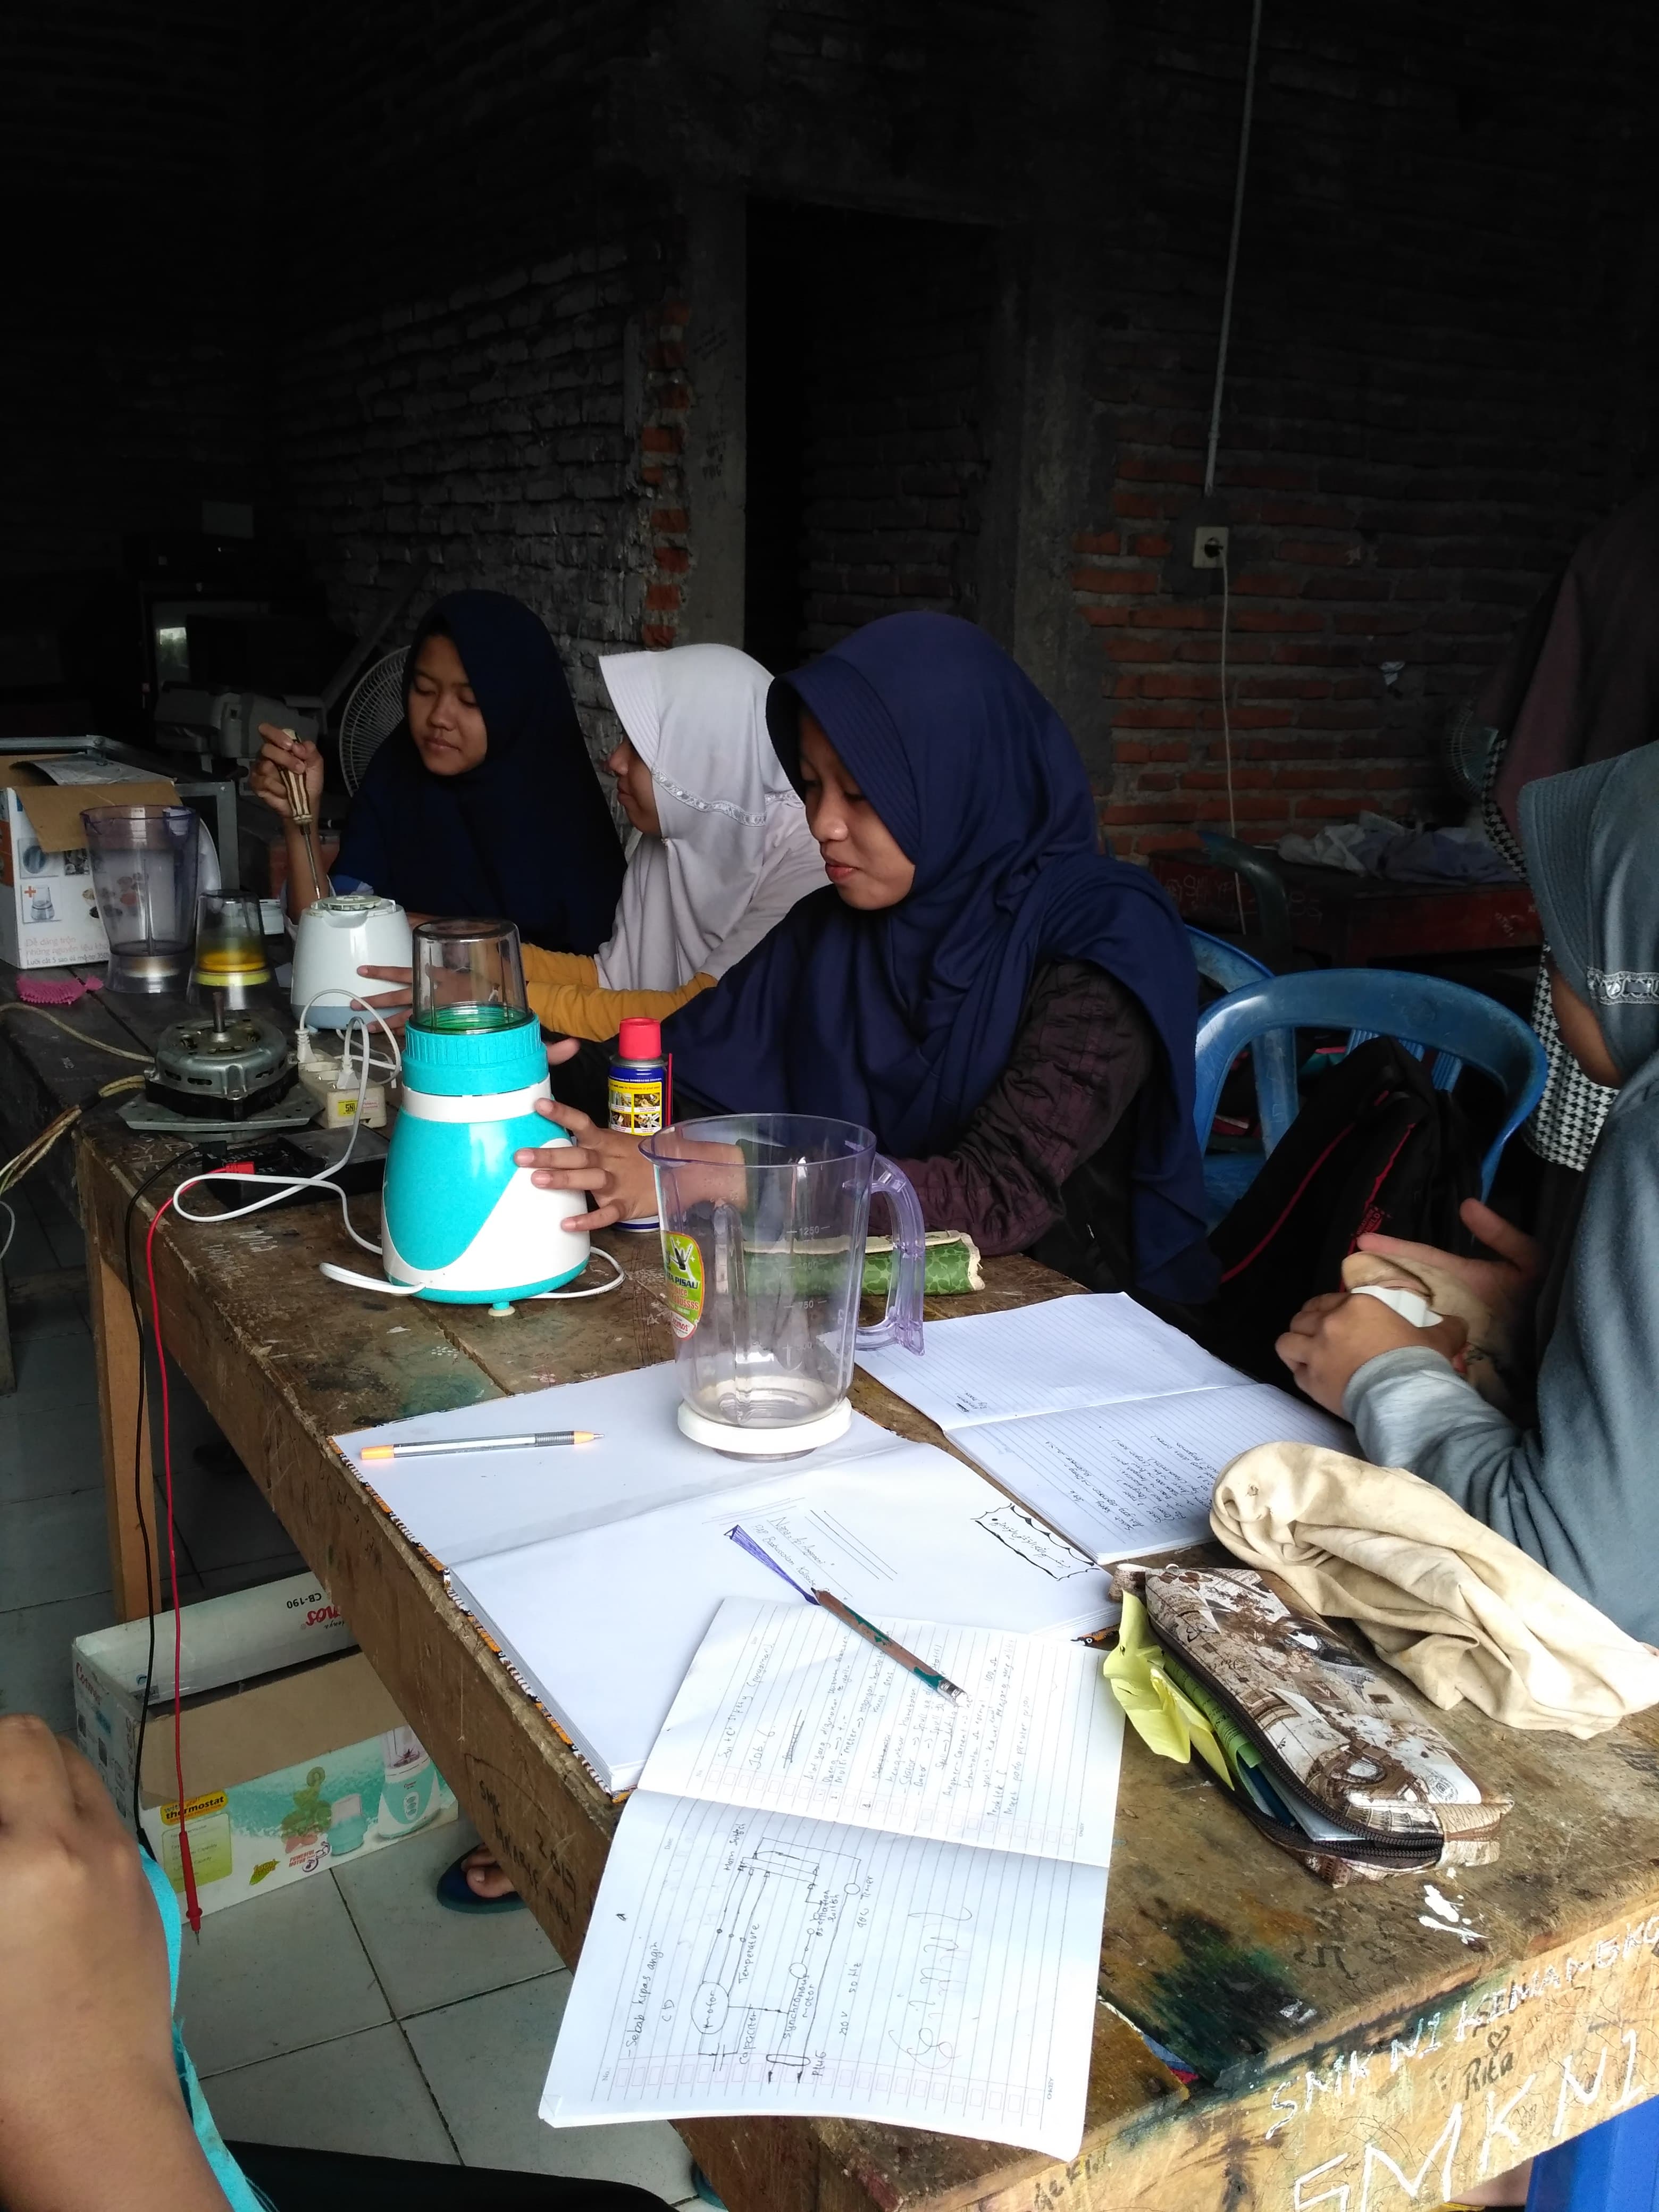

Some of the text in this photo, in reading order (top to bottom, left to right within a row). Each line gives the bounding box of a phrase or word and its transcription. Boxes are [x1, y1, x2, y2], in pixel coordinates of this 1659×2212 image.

[799, 1226, 819, 1236] 1250
[675, 1277, 698, 1289] PISAU
[287, 1593, 322, 1608] CB-190
